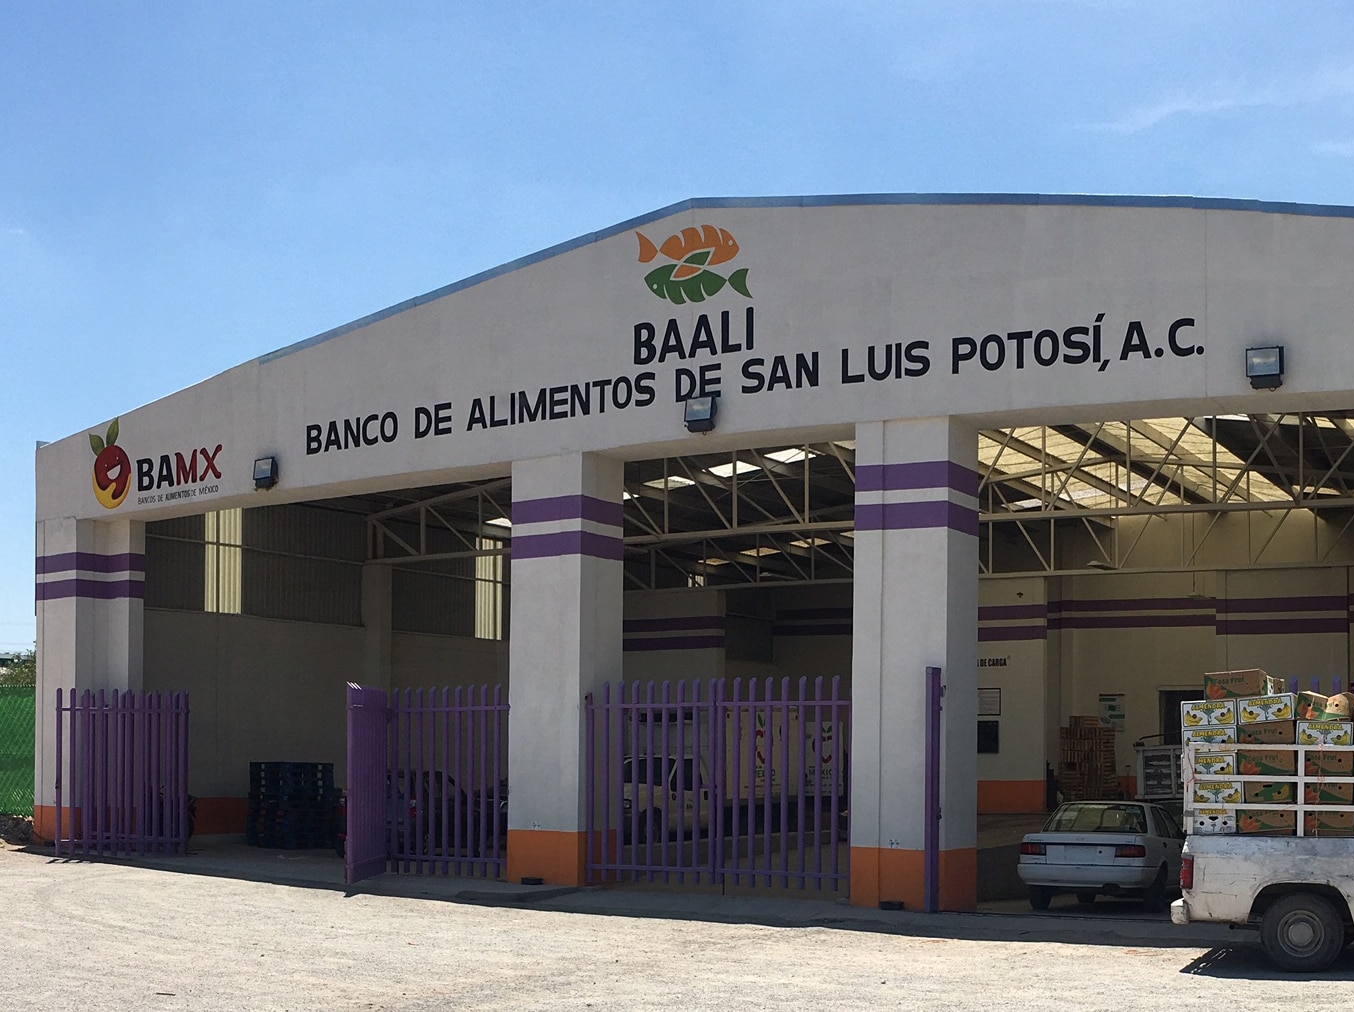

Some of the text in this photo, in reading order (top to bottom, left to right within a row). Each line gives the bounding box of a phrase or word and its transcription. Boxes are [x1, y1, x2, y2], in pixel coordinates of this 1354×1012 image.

[633, 307, 754, 365] BAALI
[306, 312, 1206, 456] BANCO DE ALIMENTOS DE SAN LUIS POTOSÍ, A.C.
[136, 444, 223, 492] BAMX
[138, 484, 219, 505] BANCOS DE ALIMENTOS DE MÉXICO
[980, 658, 1007, 667] DE CARGA
